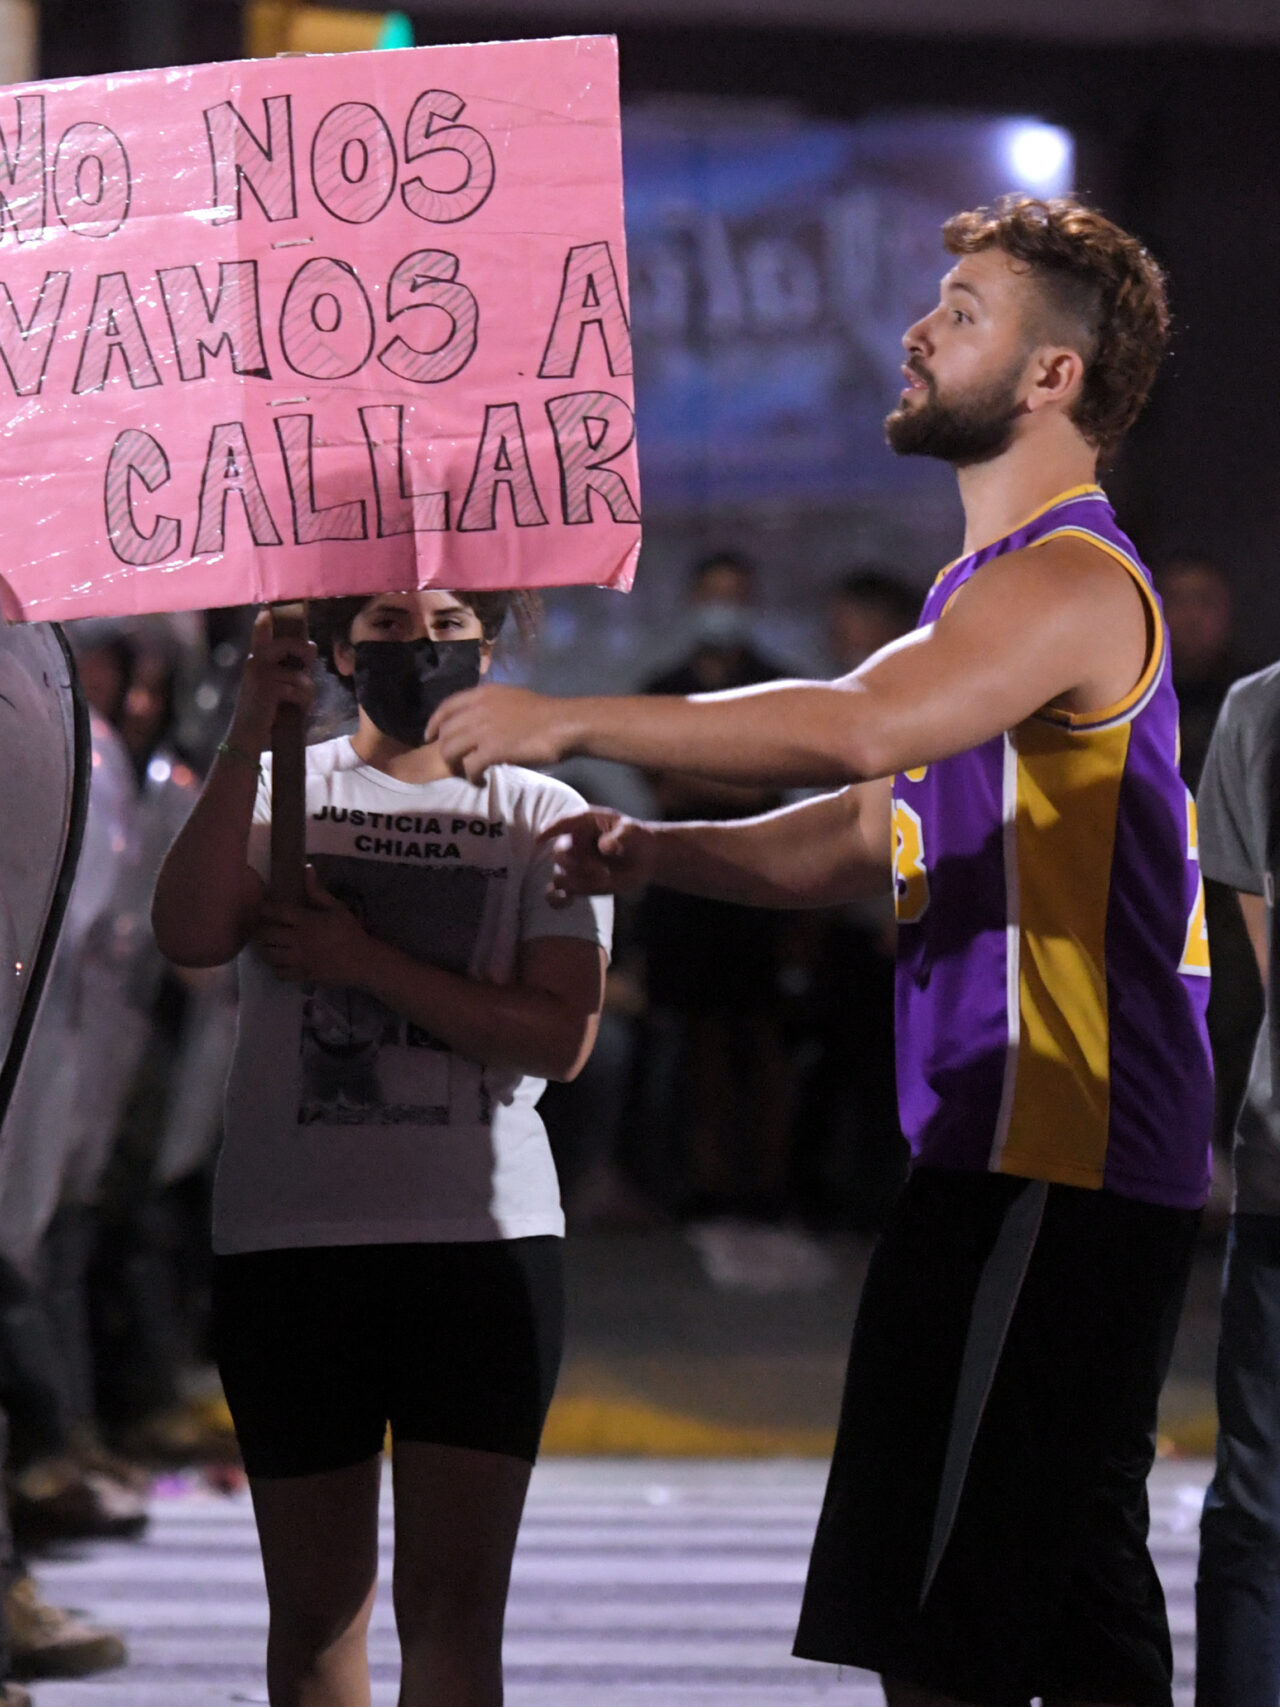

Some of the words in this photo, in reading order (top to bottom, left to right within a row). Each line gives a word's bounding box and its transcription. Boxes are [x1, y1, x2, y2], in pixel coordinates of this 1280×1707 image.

[203, 89, 495, 225] NOS
[537, 241, 632, 379] A
[104, 391, 641, 566] CALLAR
[313, 805, 441, 836] JUSTICIA
[354, 834, 461, 859] CHIARA
